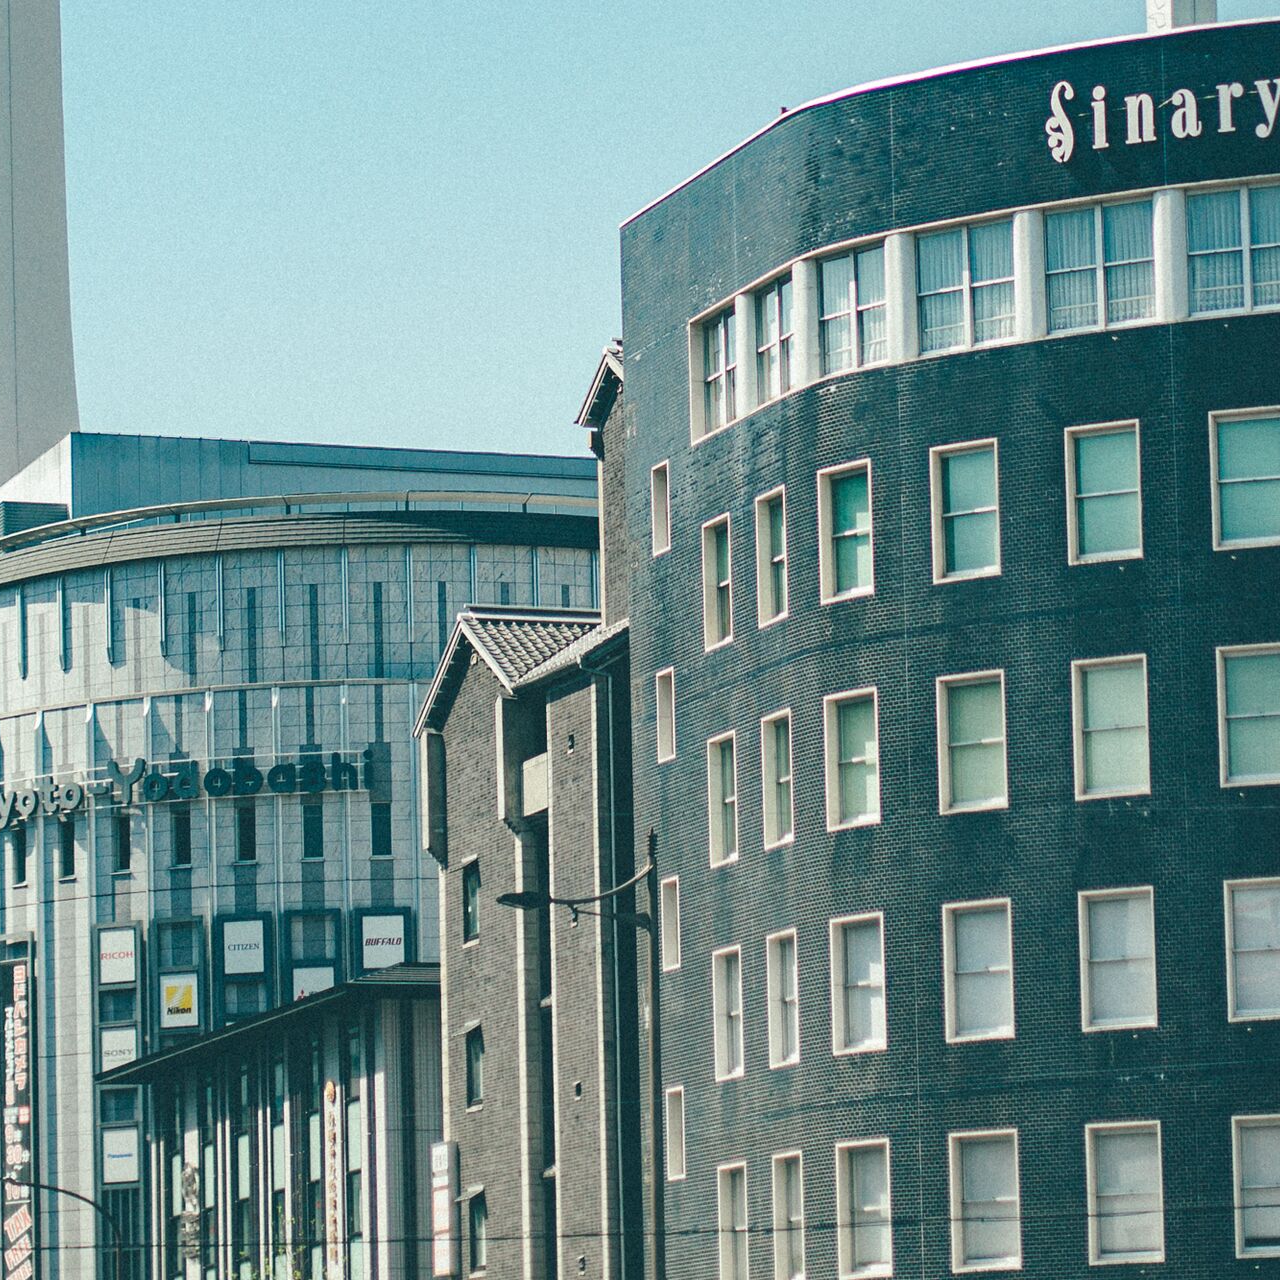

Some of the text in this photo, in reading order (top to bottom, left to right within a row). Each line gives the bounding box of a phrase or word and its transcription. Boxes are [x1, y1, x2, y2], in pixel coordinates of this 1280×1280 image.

[365, 937, 402, 946] BUFFALO
[228, 943, 260, 951] CITIZEN
[100, 951, 133, 960] RICOH
[166, 1007, 192, 1015] Nikon
[104, 1049, 133, 1058] SONY
